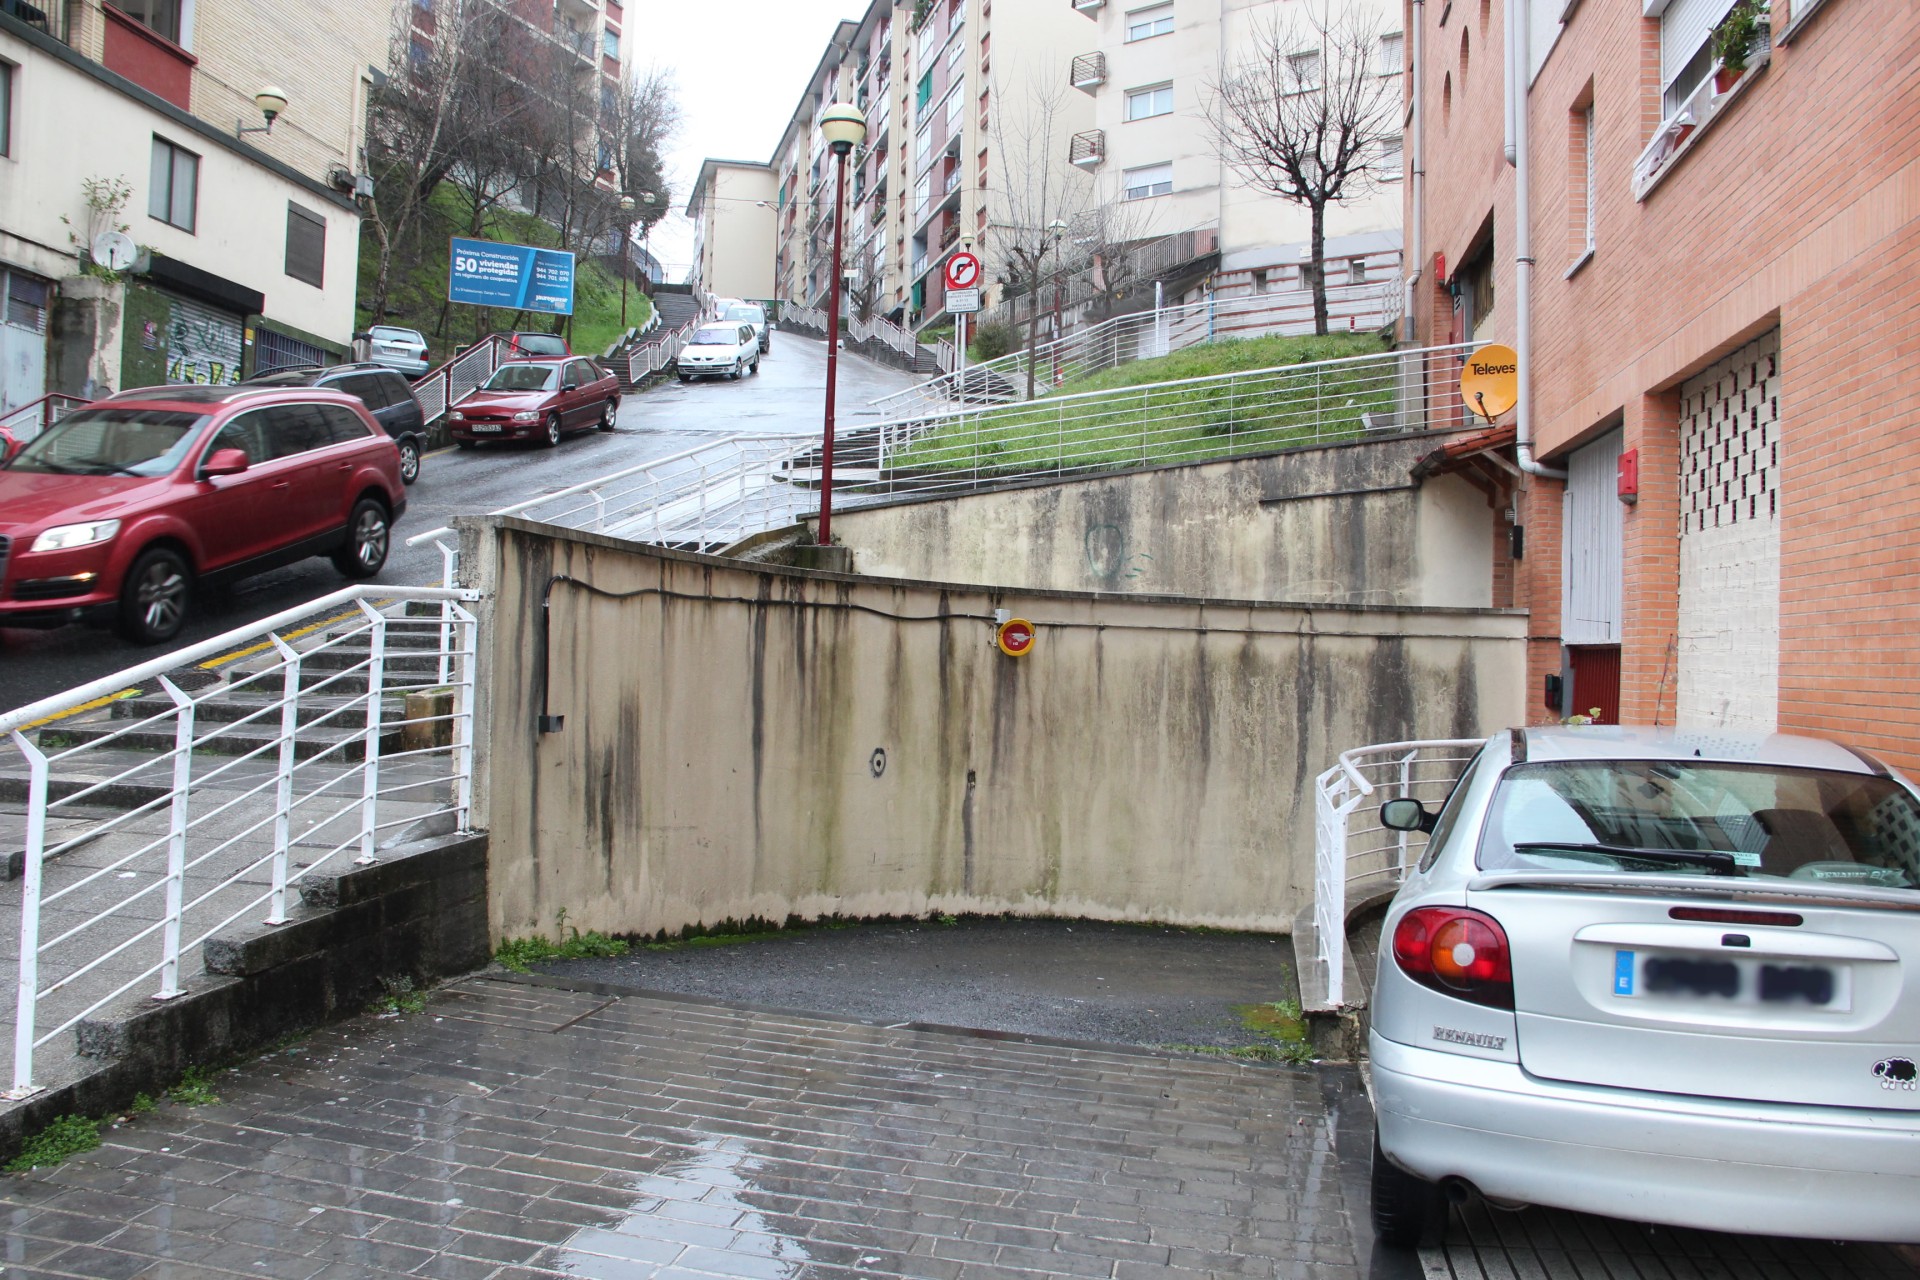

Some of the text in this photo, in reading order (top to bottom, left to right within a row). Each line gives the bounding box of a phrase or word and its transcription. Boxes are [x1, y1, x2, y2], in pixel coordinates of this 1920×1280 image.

[456, 248, 519, 262] Próxima Construcción
[455, 256, 519, 273] 50 viviendas
[478, 267, 519, 277] protegidas
[1470, 362, 1516, 376] Televes
[1619, 976, 1629, 988] E
[1432, 1024, 1507, 1051] RENAULT
